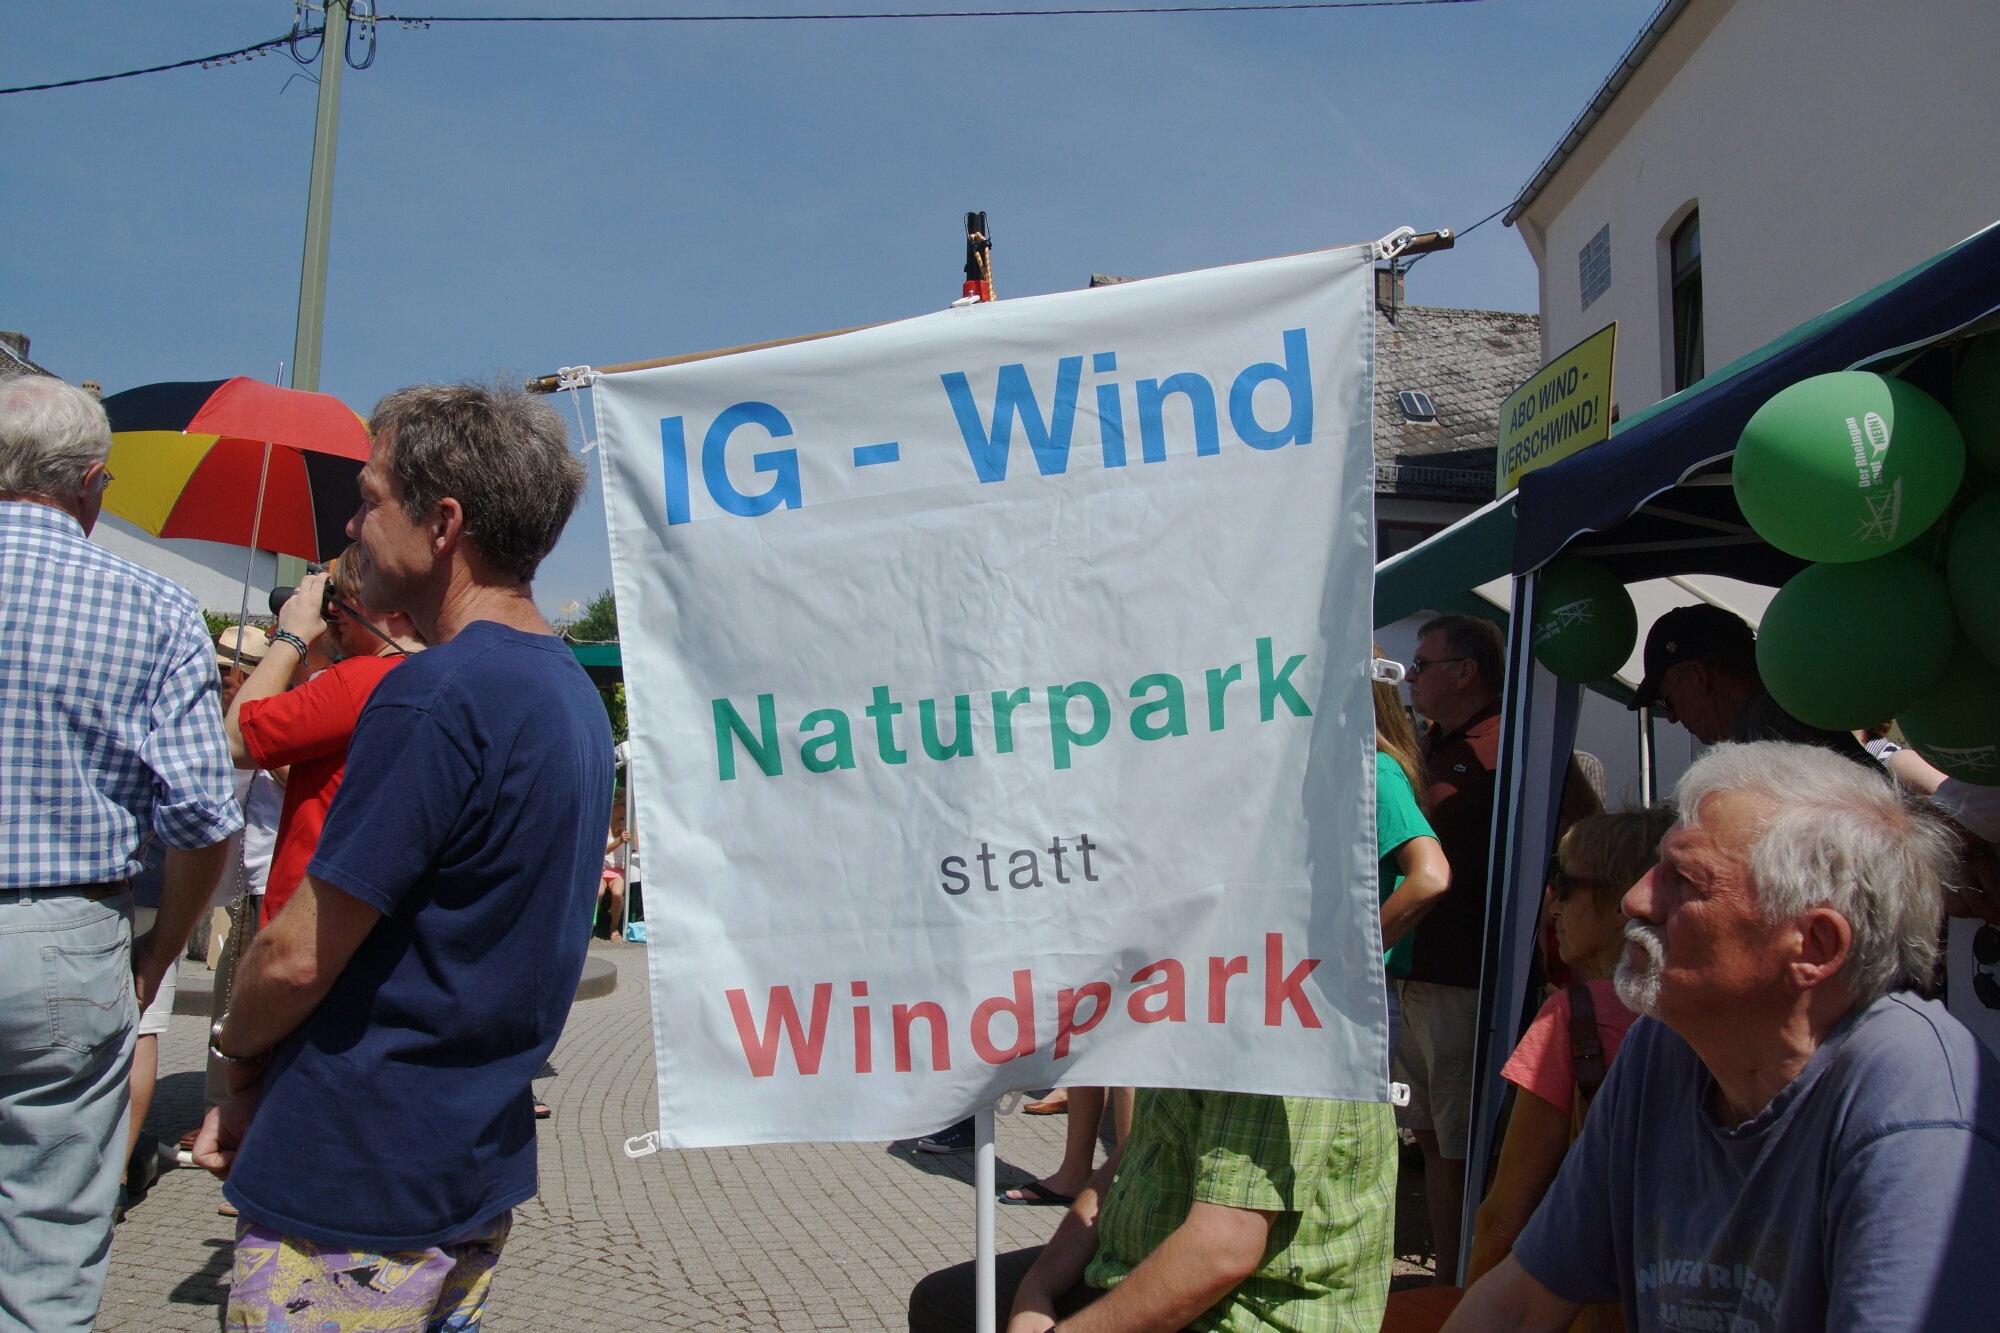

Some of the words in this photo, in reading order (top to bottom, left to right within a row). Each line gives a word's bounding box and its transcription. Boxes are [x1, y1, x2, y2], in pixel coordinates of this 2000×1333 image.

[660, 401, 802, 525] IG
[853, 442, 900, 467] -
[940, 328, 1313, 483] Wind
[1510, 394, 1535, 434] ABO
[1539, 366, 1578, 414] WIND
[1867, 416, 1886, 445] NEIN!
[1502, 395, 1599, 477] VERSCHWIND!
[1845, 417, 1867, 467] Rheingau
[1858, 469, 1870, 488] Der
[1870, 460, 1883, 485] sagt
[712, 637, 1312, 781] Naturpark
[941, 834, 1098, 895] statt
[726, 933, 1321, 1077] Windpark
